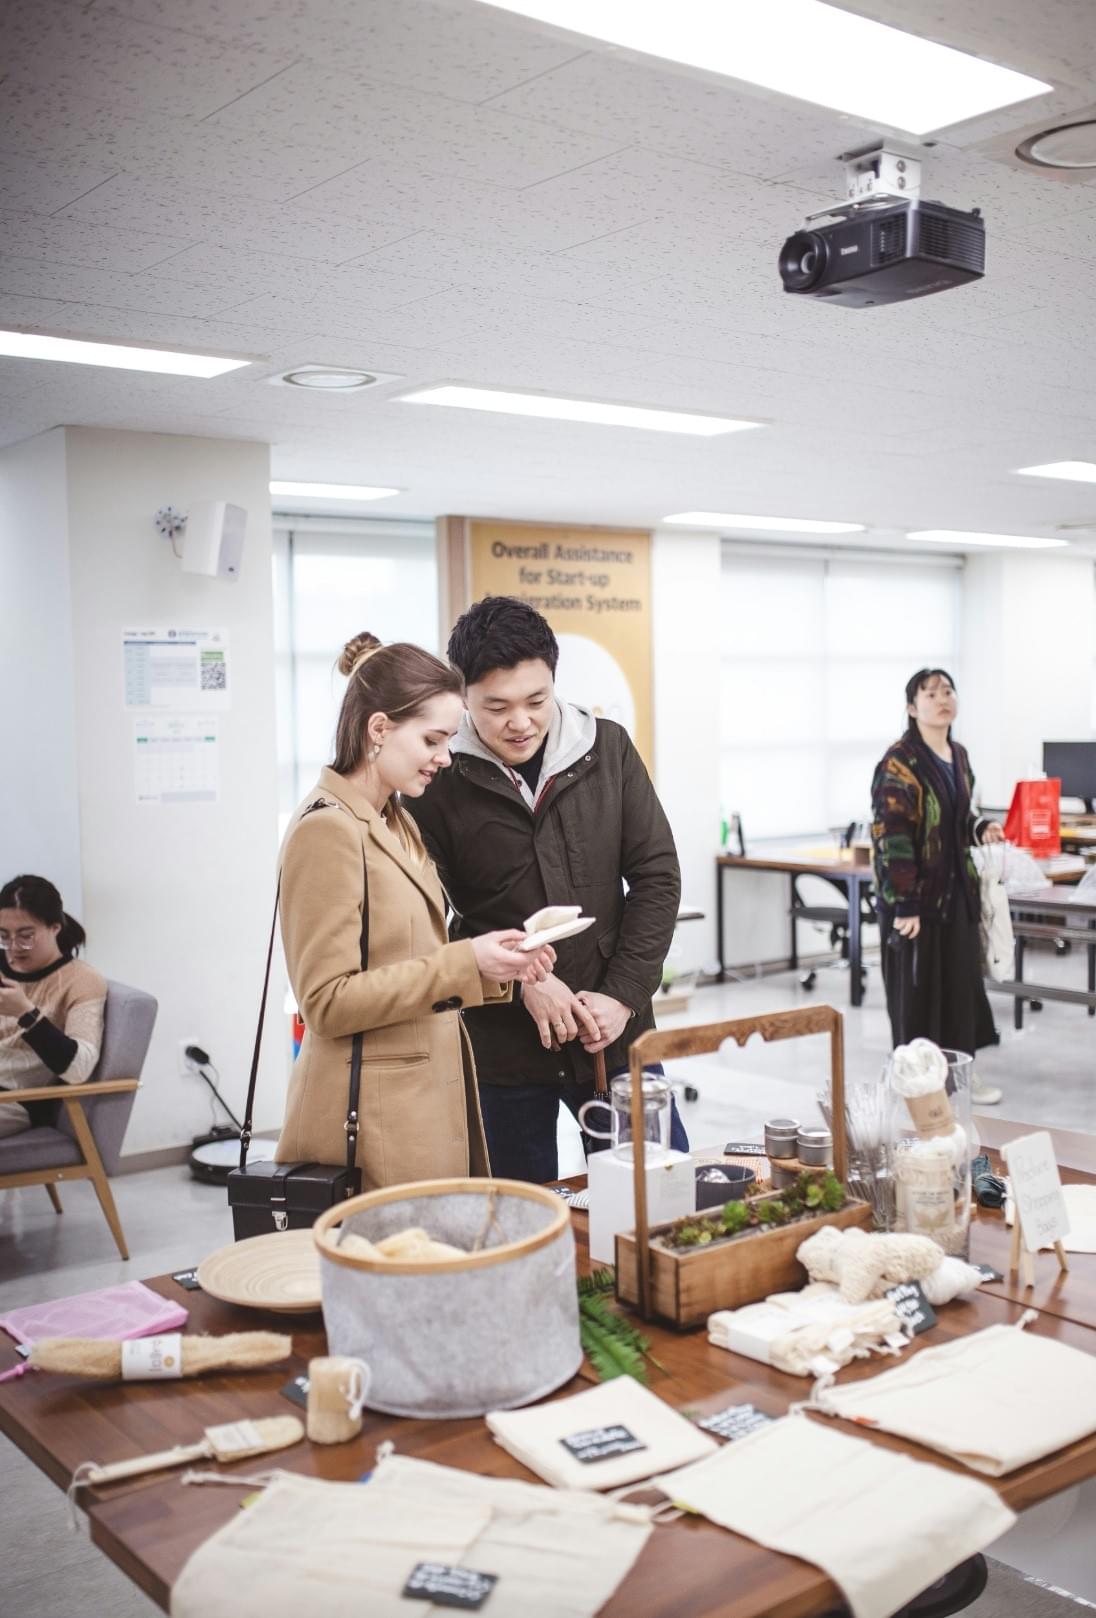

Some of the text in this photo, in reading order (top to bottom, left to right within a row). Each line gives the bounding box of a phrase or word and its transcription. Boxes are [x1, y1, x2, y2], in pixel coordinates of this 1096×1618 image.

[491, 541, 633, 564] Overall Assistance
[519, 567, 609, 589] for Start-up
[586, 595, 642, 615] System
